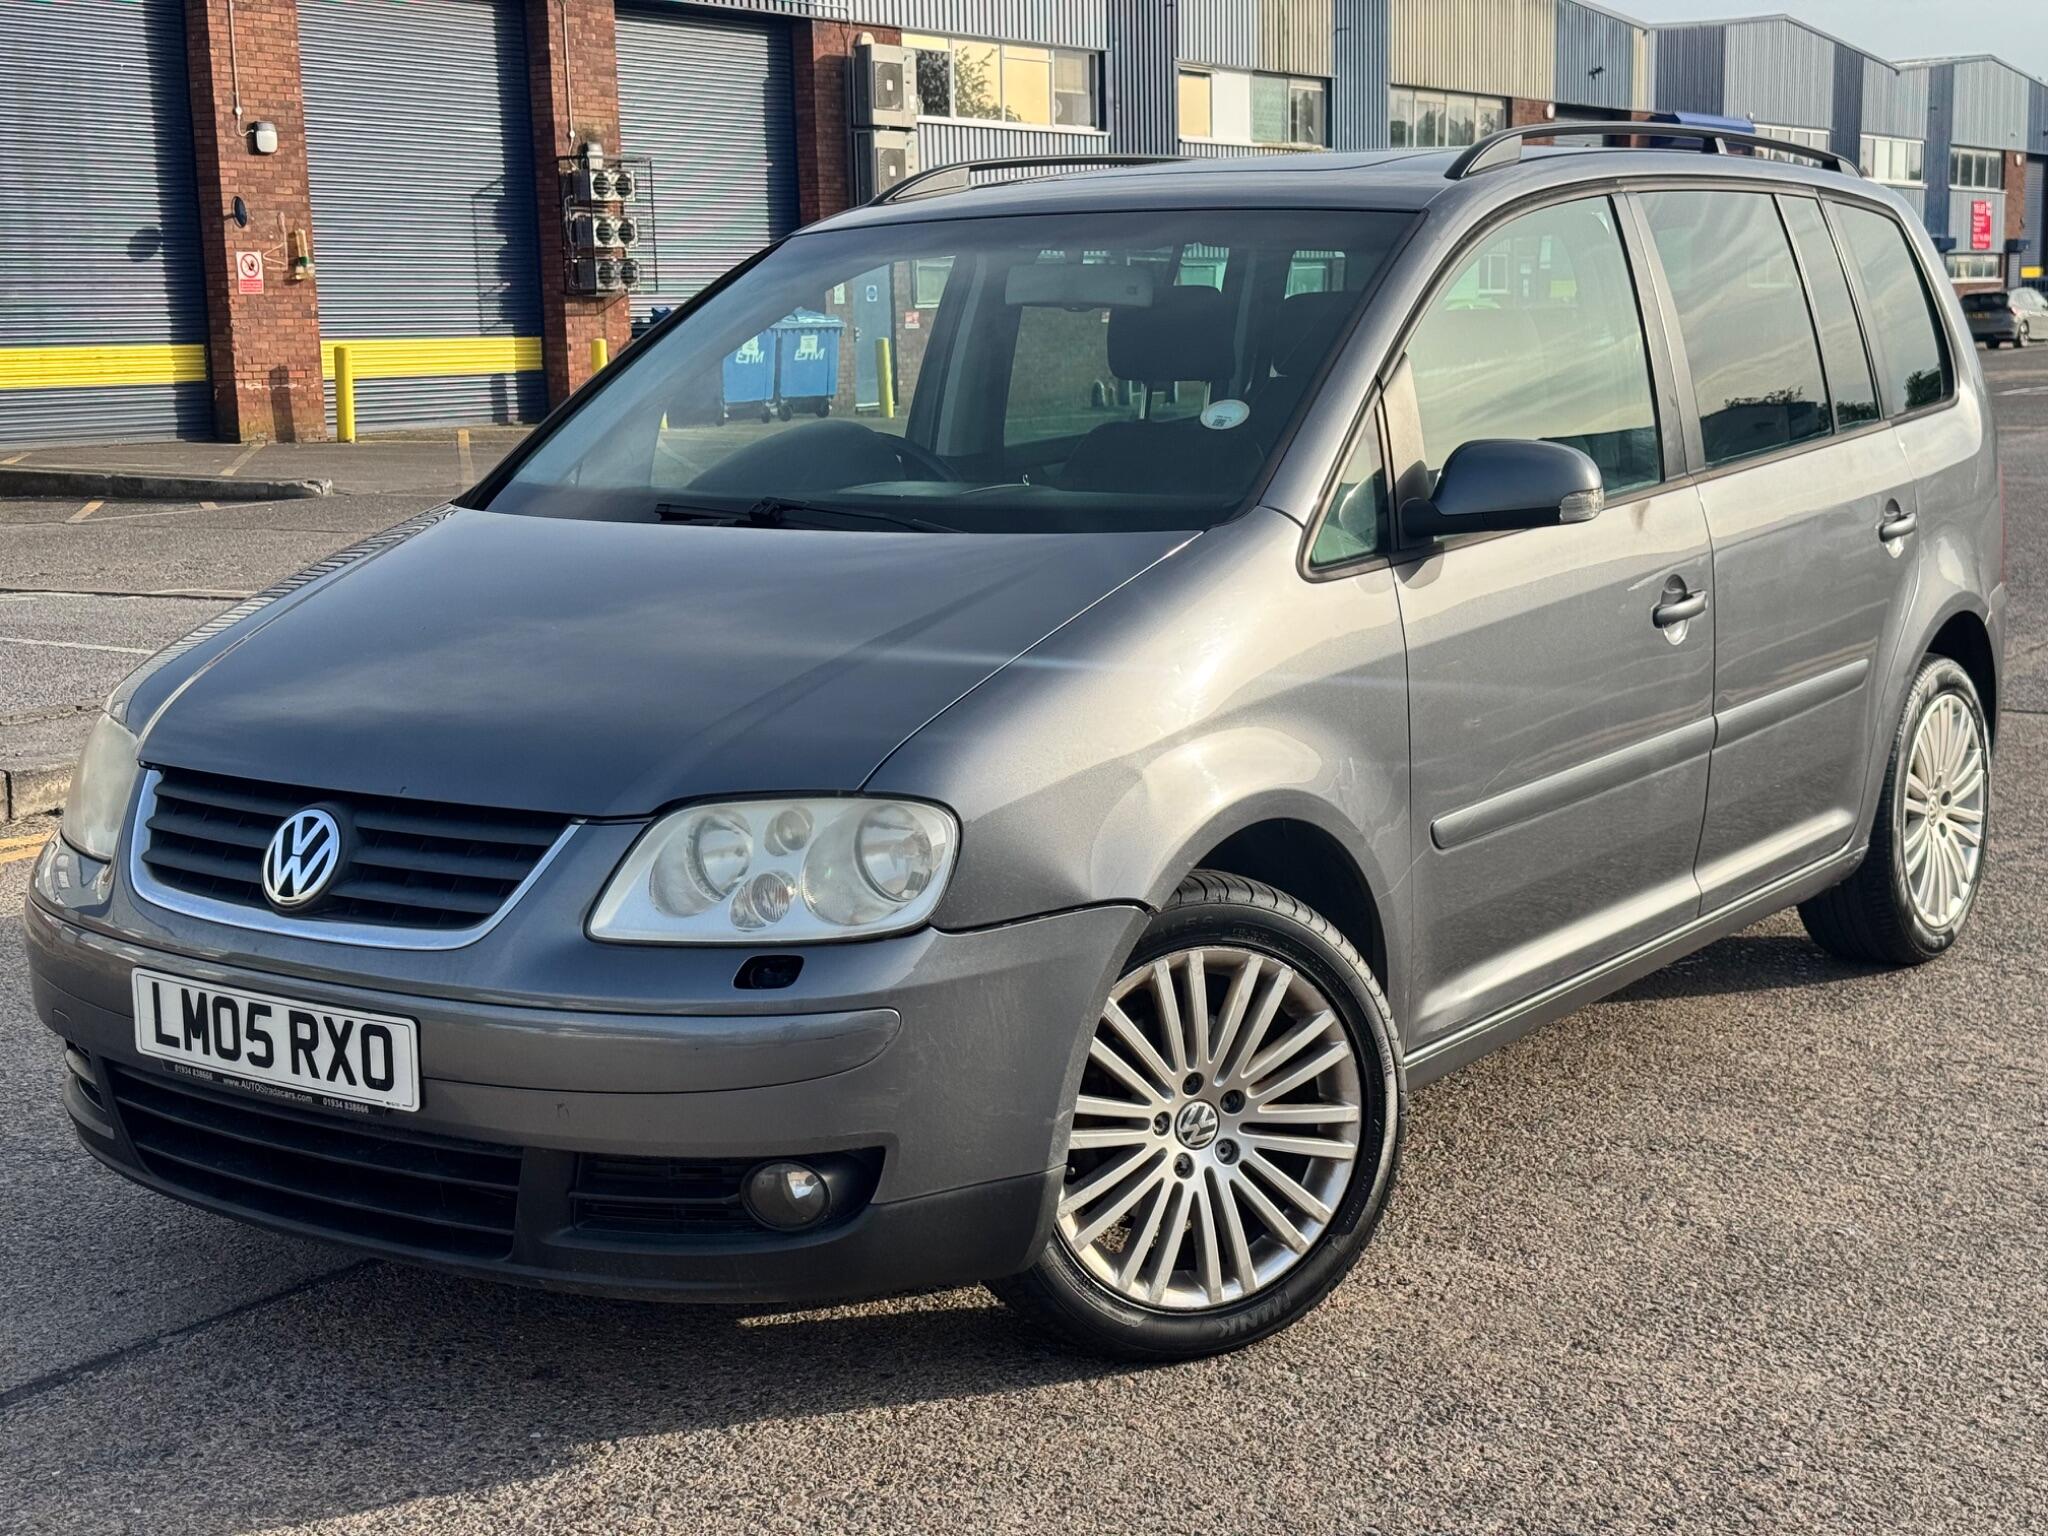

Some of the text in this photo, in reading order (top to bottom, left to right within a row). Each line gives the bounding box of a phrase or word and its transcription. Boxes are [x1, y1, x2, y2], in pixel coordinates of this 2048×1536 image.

[263, 809, 340, 906] VW
[152, 981, 394, 1092] LM05 RXO
